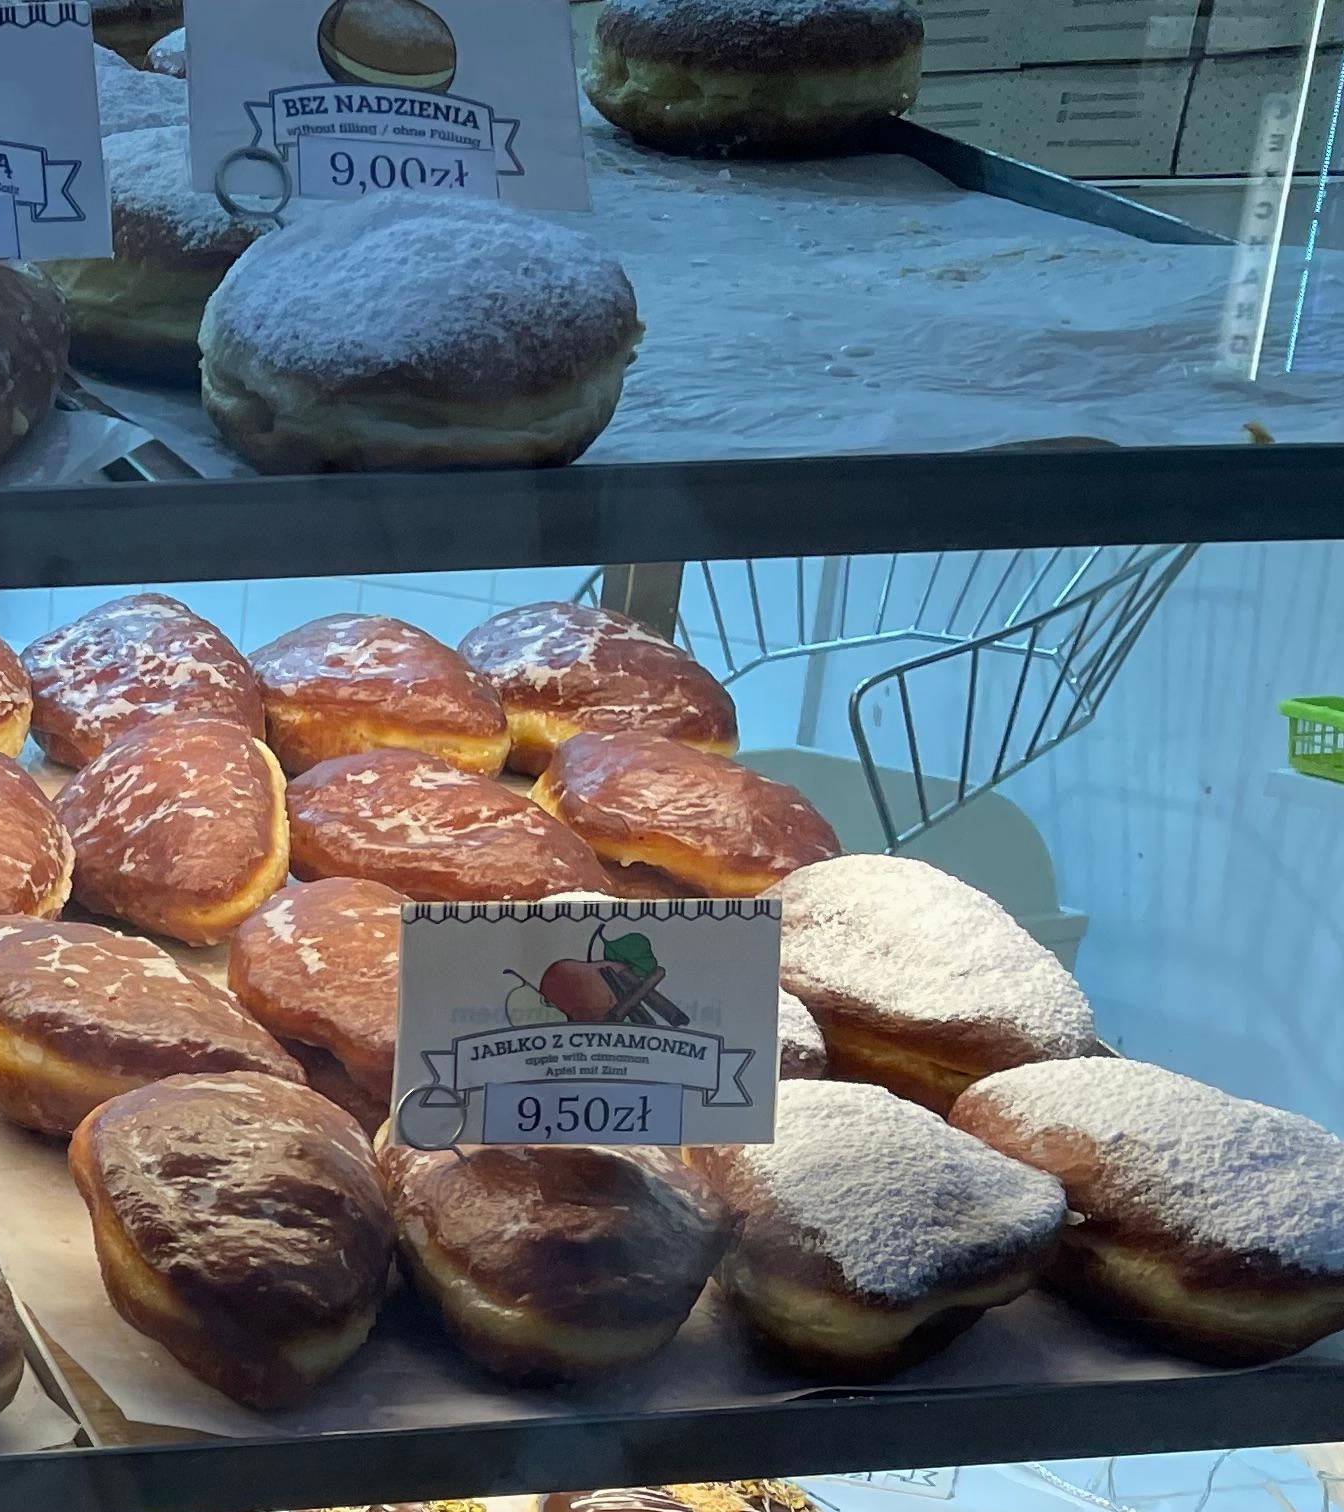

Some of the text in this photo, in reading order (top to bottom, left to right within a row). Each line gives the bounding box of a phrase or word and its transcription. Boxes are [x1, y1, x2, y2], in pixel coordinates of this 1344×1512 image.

[283, 93, 480, 130] BEZ NADZIENIA
[339, 122, 377, 136] filling
[393, 125, 426, 137] ohne
[552, 1034, 563, 1049] Z
[569, 1033, 708, 1060] CYNAMONEM
[562, 1052, 588, 1062] with
[517, 1095, 653, 1139] 9,50zł
